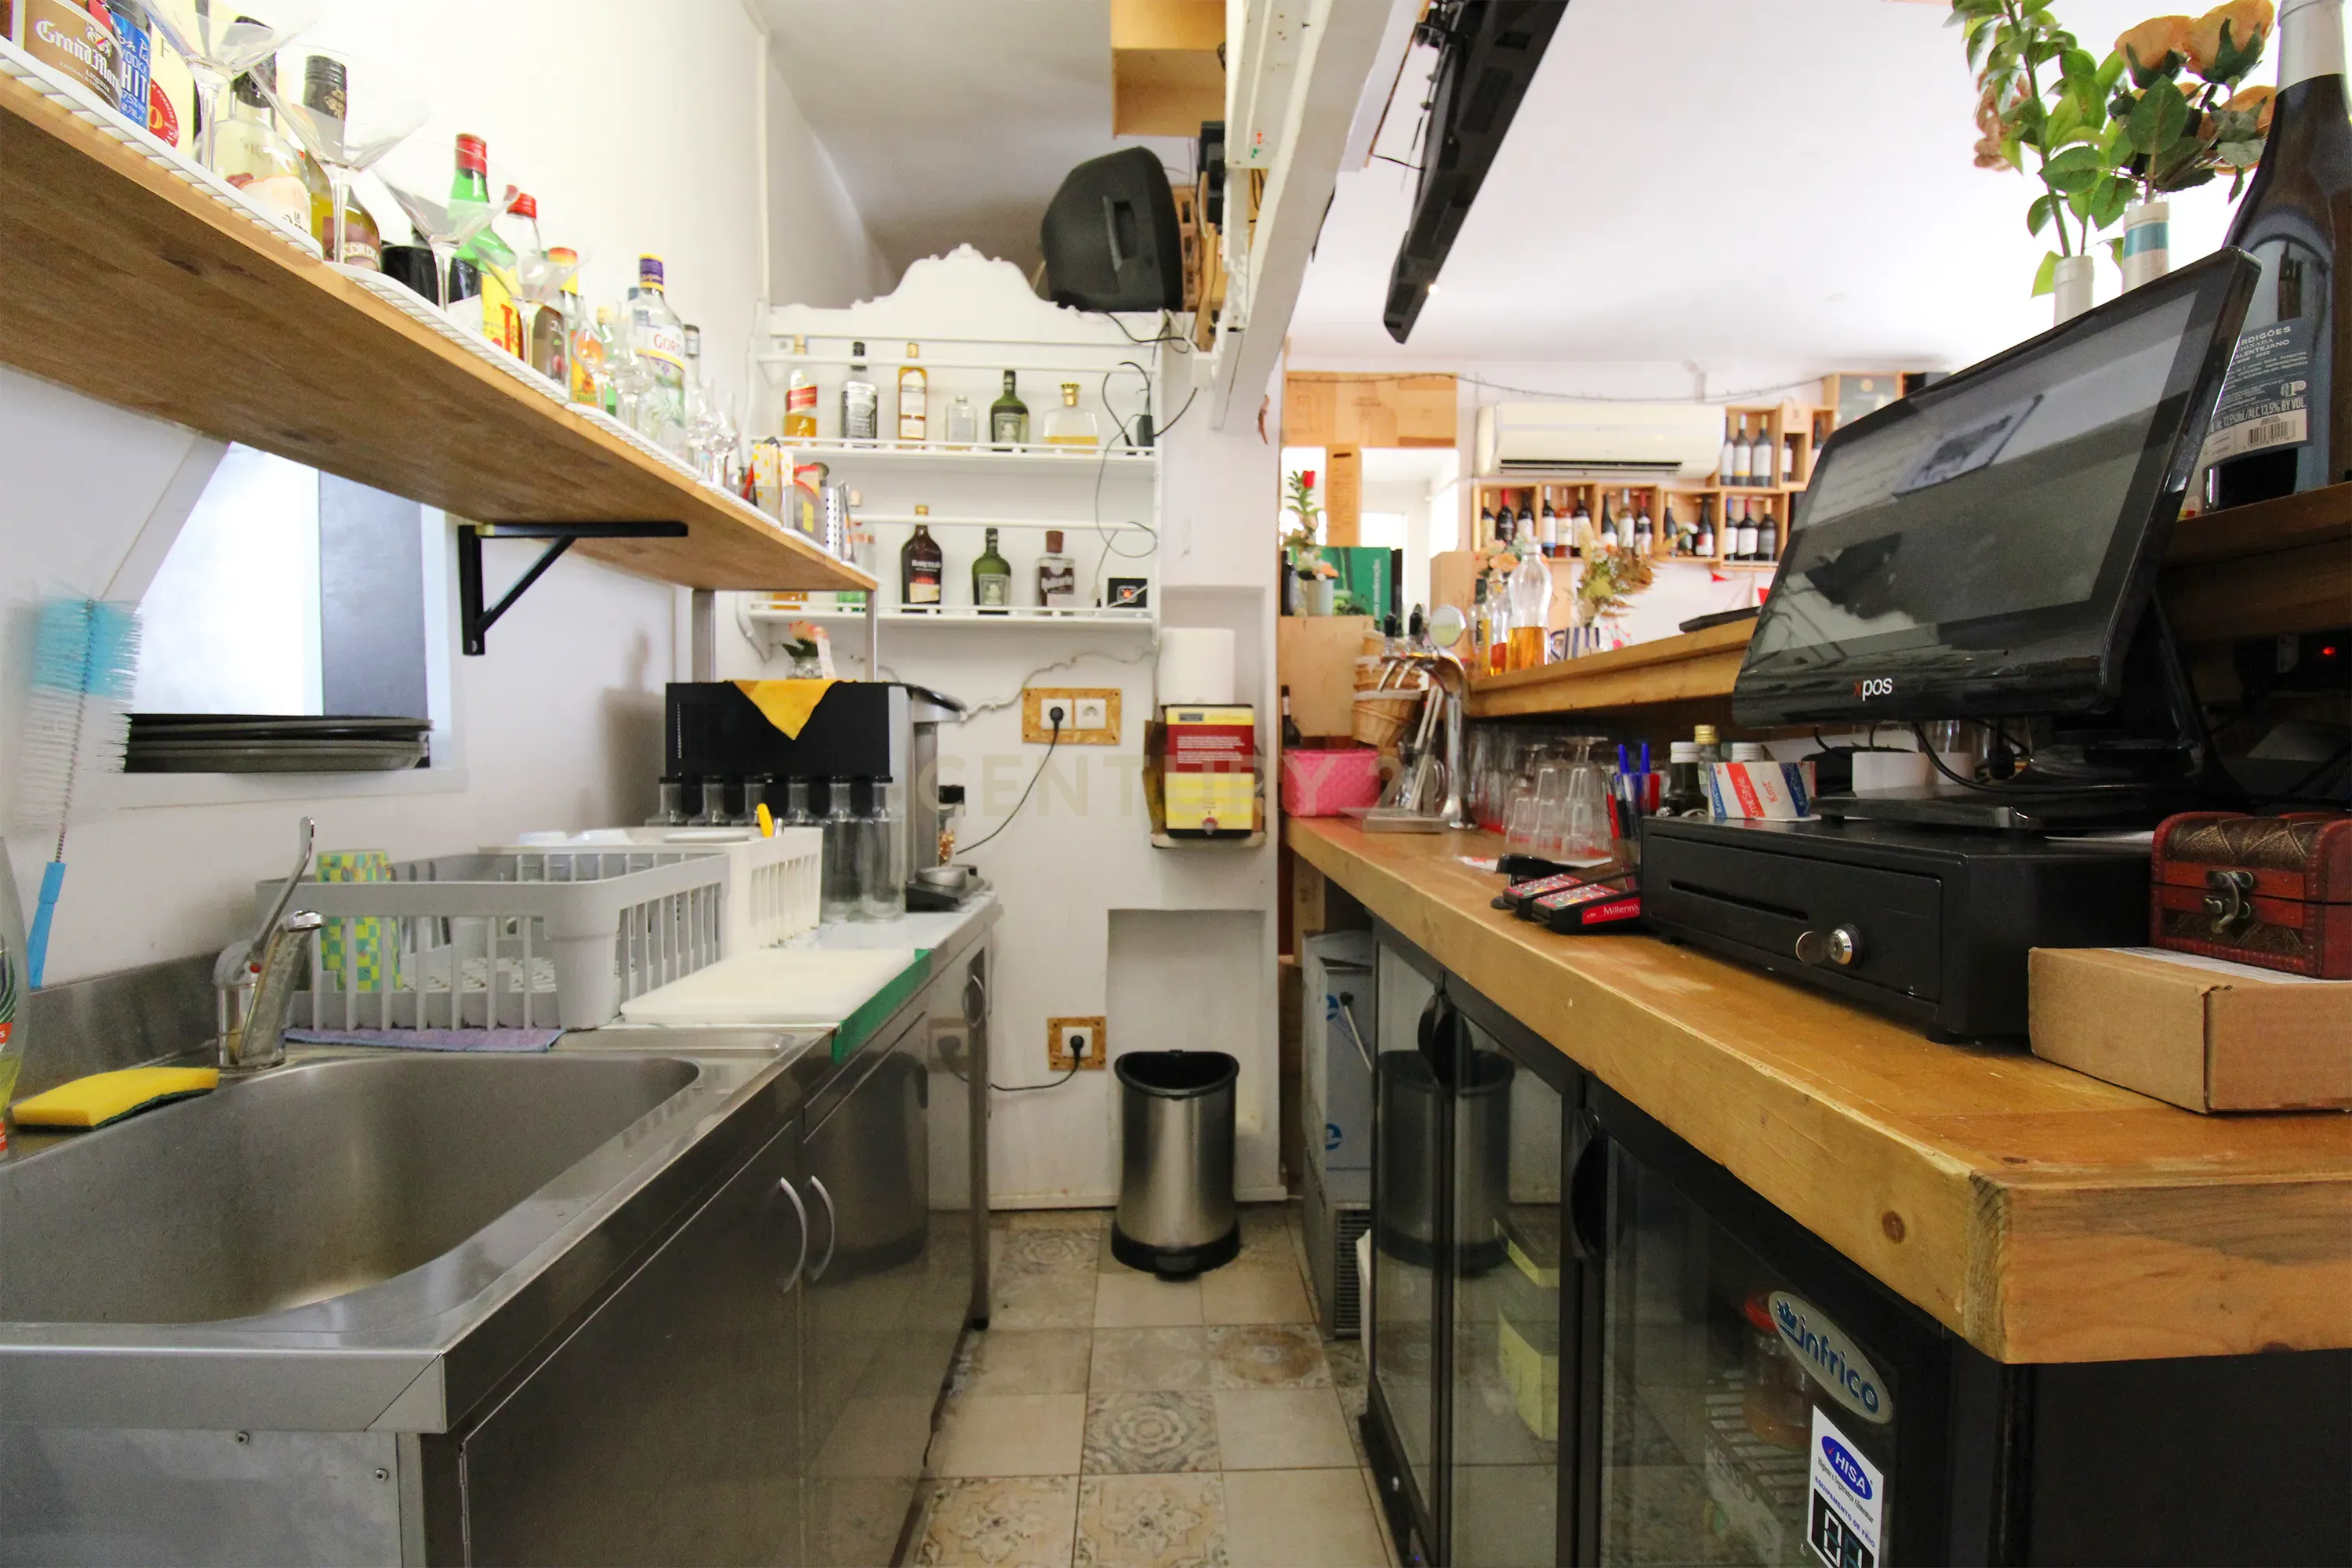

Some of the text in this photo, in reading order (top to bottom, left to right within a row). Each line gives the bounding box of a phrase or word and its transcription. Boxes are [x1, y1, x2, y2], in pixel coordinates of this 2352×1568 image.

[35, 20, 93, 66] Grand
[2238, 325, 2292, 346] RDIGÕES
[1853, 677, 1893, 702] xpos
[1797, 1315, 1880, 1415] infrico
[1835, 1451, 1867, 1494] HISA
[1815, 1475, 1875, 1548] EQUIPAMENTO DE FRIO
